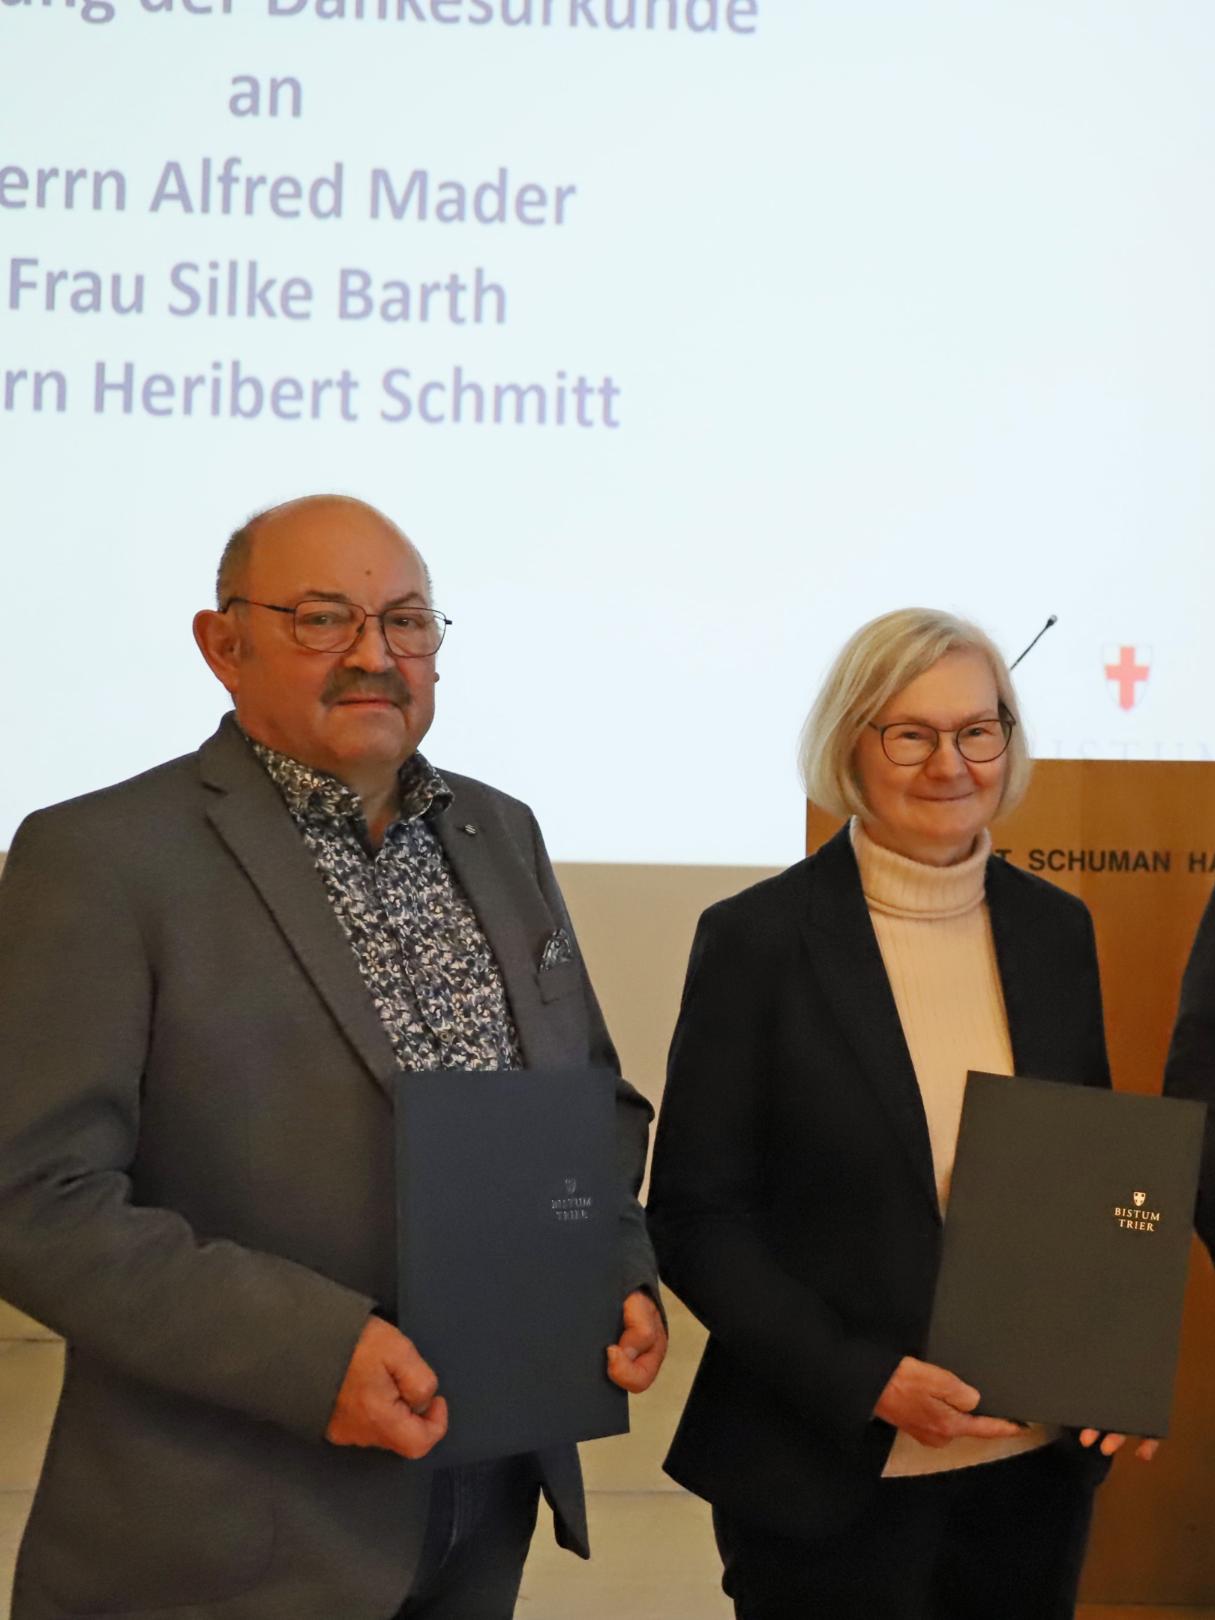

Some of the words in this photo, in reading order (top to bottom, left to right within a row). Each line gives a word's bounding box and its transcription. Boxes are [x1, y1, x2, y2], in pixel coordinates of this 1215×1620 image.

[228, 74, 304, 118] an
[150, 157, 344, 220] Alfred
[369, 166, 577, 226] Mader
[8, 257, 145, 315] Frau
[168, 259, 314, 320] Silke
[338, 267, 506, 325] Barth
[93, 359, 359, 422] Heribert
[380, 365, 620, 429] Schmitt
[1028, 849, 1171, 873] SCHUMAN
[1114, 1207, 1160, 1221] BISTUM
[1119, 1219, 1155, 1232] TRIER
